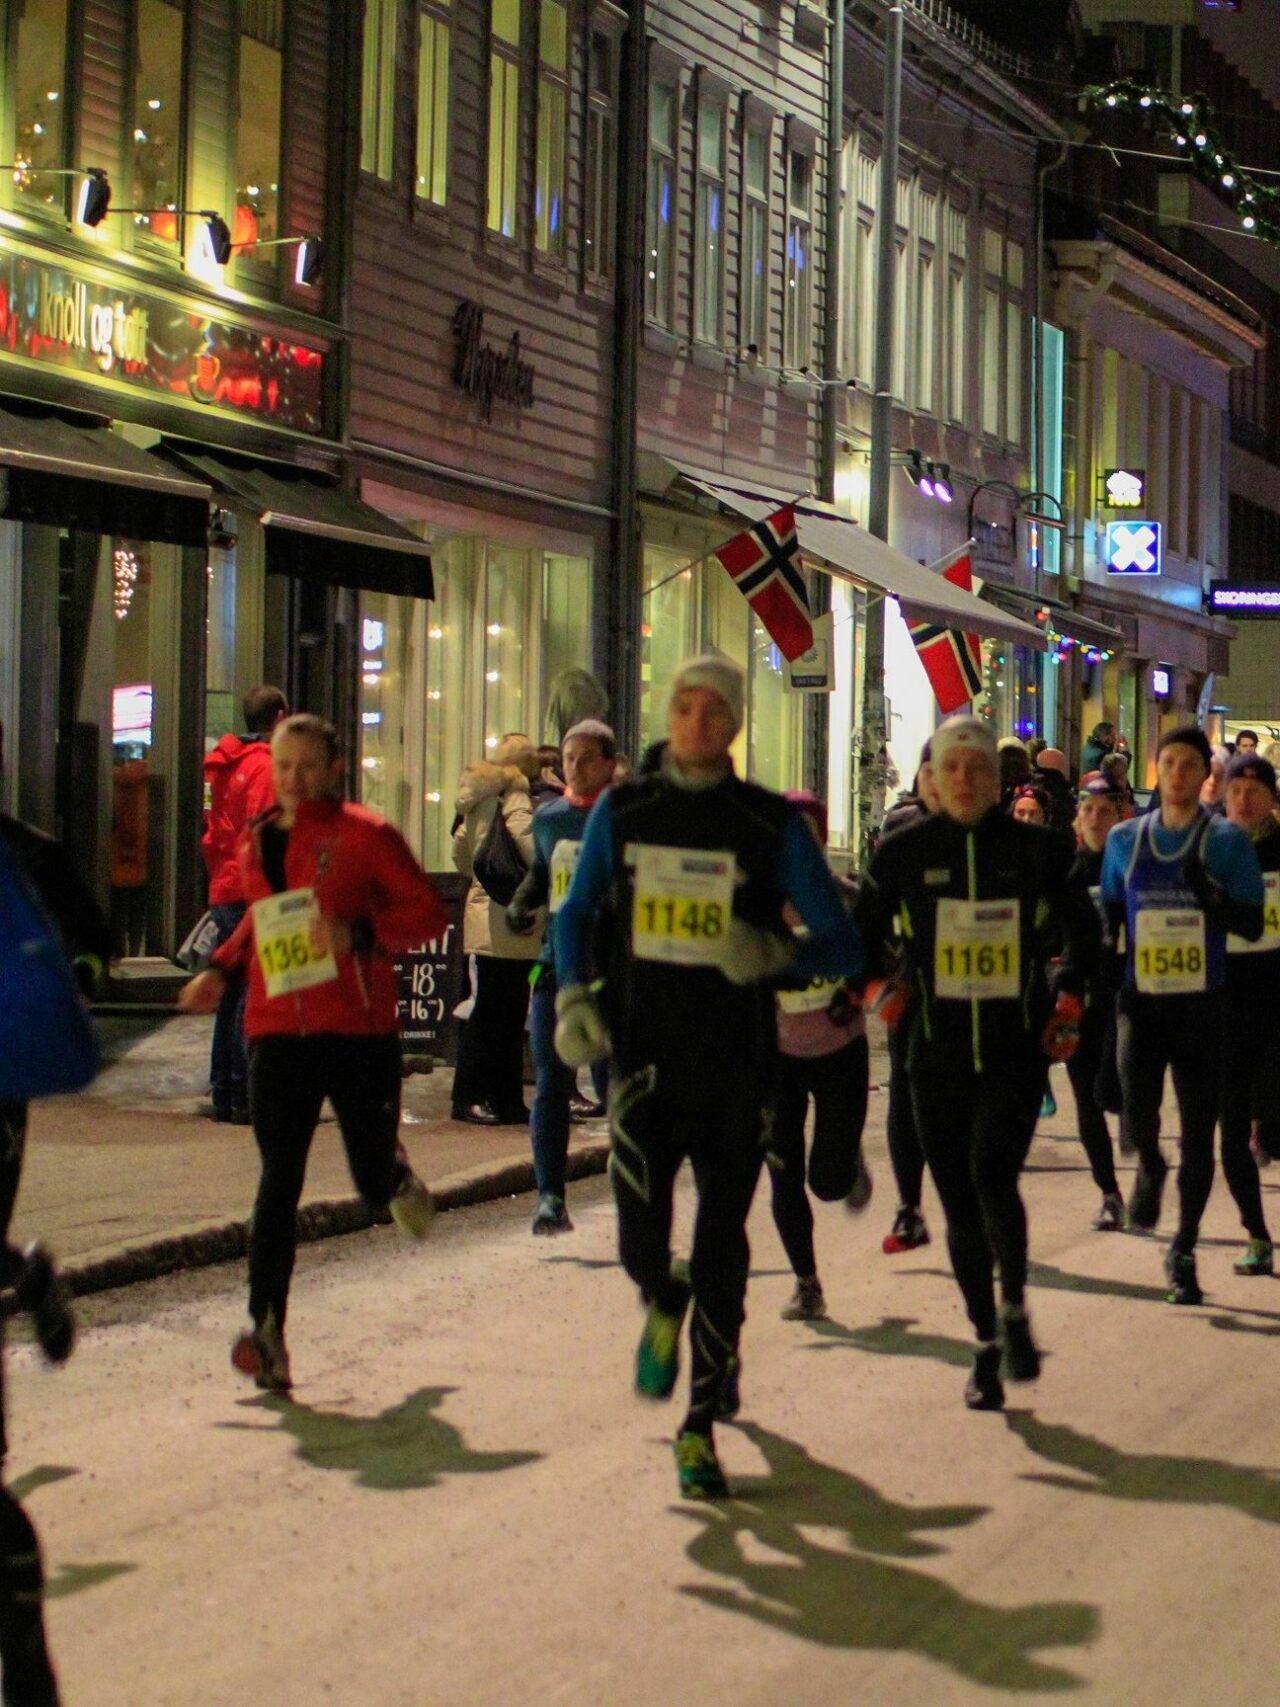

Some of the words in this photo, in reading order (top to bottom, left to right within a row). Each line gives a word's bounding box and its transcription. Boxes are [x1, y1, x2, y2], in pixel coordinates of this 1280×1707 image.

[40, 271, 87, 348] knoll
[89, 303, 113, 372] og
[644, 901, 723, 938] 1148
[943, 944, 1010, 976] 1161
[1140, 946, 1200, 975] 1548
